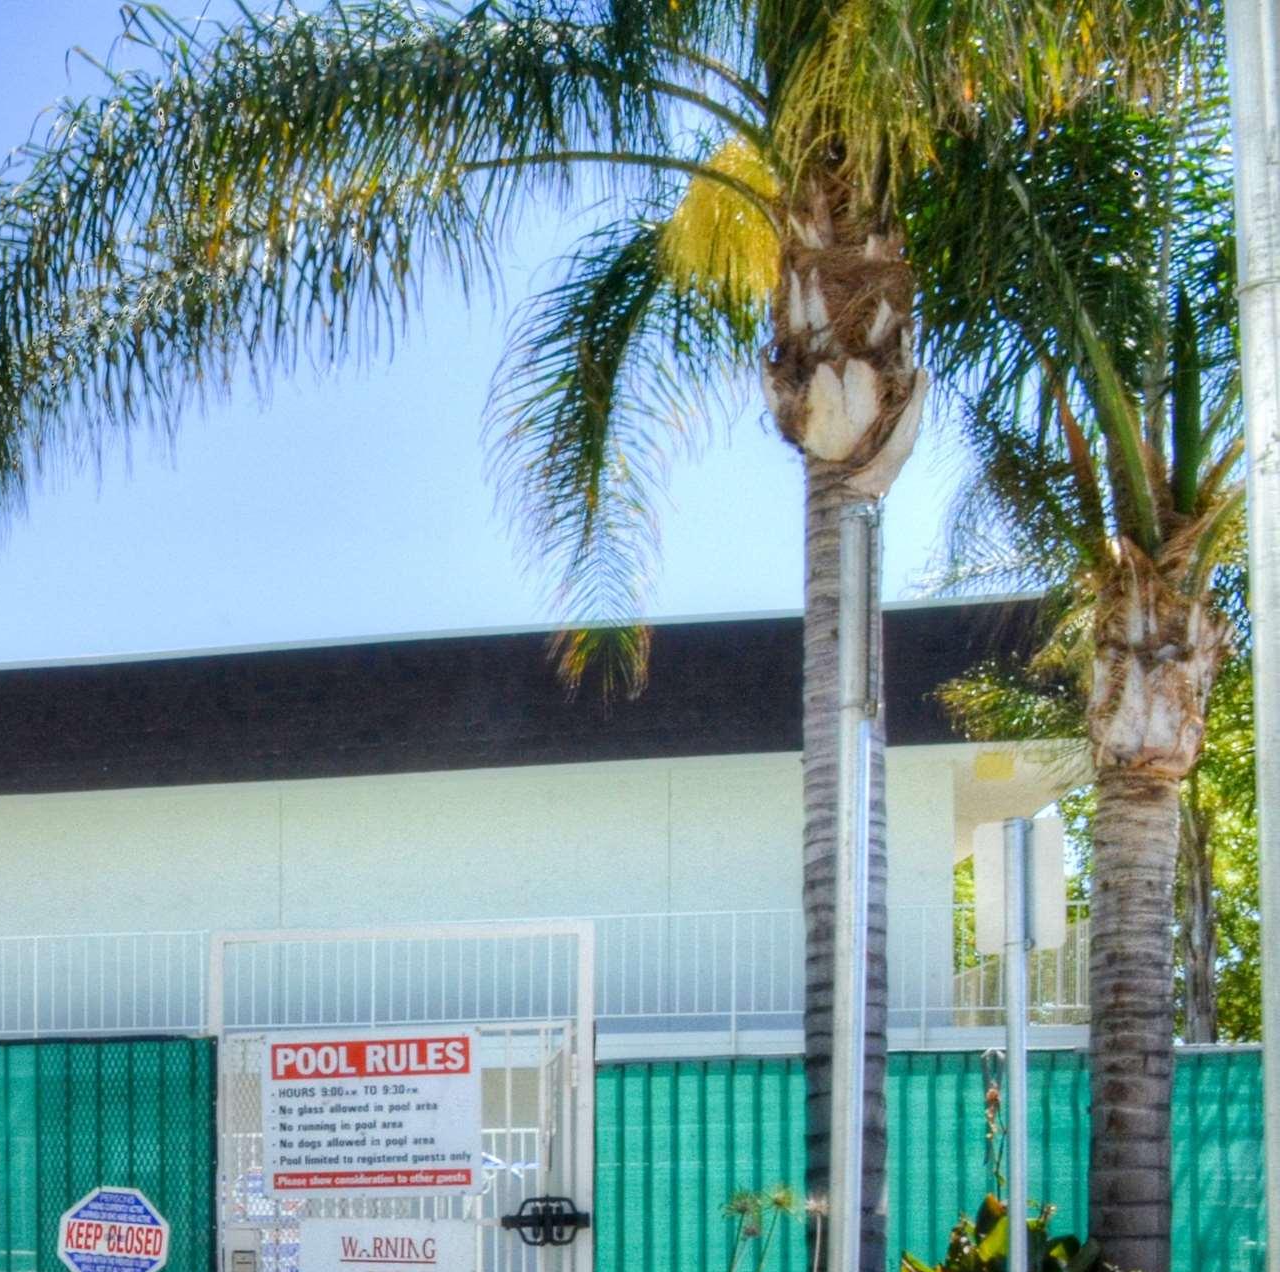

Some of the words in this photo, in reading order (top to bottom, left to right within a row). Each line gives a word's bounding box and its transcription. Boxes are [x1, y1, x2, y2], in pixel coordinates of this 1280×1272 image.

[275, 1046, 357, 1076] POOL
[365, 1041, 466, 1073] RULES
[278, 1086, 315, 1098] HOURS
[363, 1085, 378, 1096] TO
[279, 1105, 293, 1115] No
[298, 1104, 323, 1116] glass
[329, 1103, 369, 1114] allowed
[374, 1103, 383, 1112] in
[388, 1102, 411, 1114] pool
[415, 1102, 438, 1111] area
[279, 1122, 293, 1132] No
[298, 1122, 337, 1132] running
[341, 1120, 351, 1130] in
[355, 1120, 377, 1132] pool
[381, 1120, 403, 1129] area
[279, 1139, 293, 1149] No
[298, 1138, 321, 1150] dogs
[327, 1137, 367, 1148] allowed
[371, 1136, 381, 1146] in
[385, 1136, 407, 1148] pool
[413, 1136, 435, 1144] area
[279, 1155, 301, 1166] Pool
[305, 1154, 340, 1164] limited
[343, 1154, 353, 1164] to
[357, 1152, 409, 1166] registered
[411, 1152, 445, 1164] guests
[450, 1151, 472, 1163] only
[278, 1176, 307, 1186] Please
[309, 1175, 333, 1186] show
[335, 1174, 395, 1185] consideration
[397, 1174, 407, 1184] to
[409, 1173, 434, 1184] other
[436, 1172, 467, 1184] guests
[65, 1220, 103, 1251] KEEP
[107, 1224, 164, 1256] CLOSED
